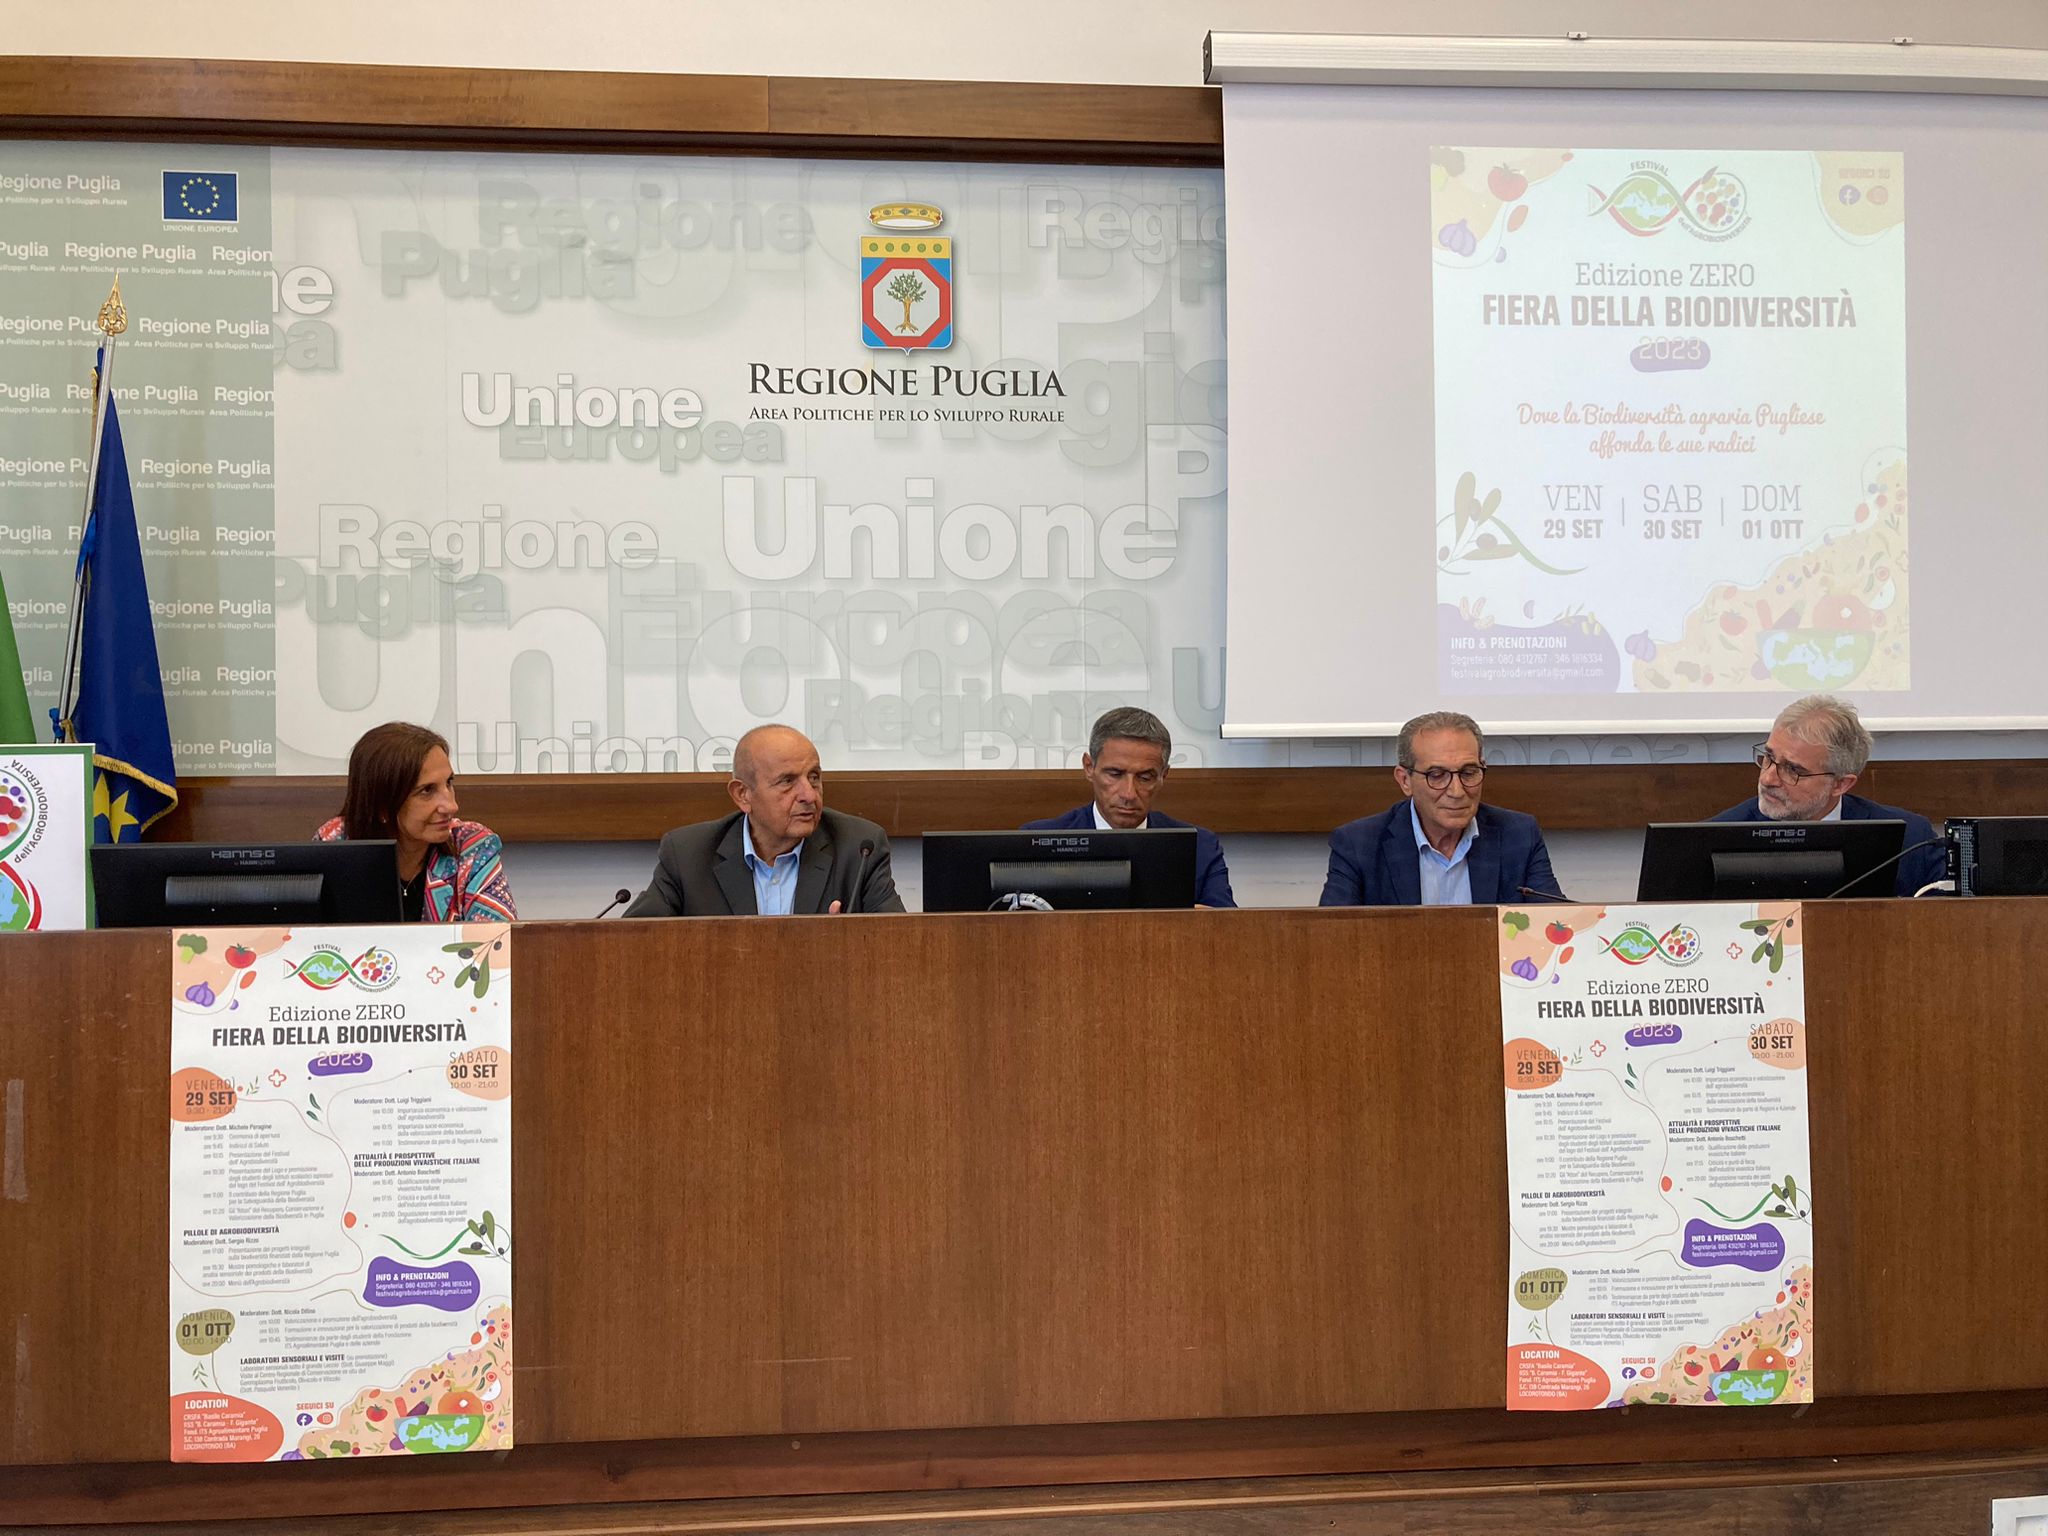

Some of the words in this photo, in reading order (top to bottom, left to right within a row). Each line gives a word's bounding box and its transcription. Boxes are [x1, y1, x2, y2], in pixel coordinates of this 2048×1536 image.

[1630, 160, 1669, 176] FESTIVAL
[0, 174, 62, 192] egione
[67, 175, 121, 193] Puglia
[478, 180, 812, 256] Regione
[65, 242, 137, 261] Regione
[143, 244, 195, 262] Puglia
[381, 231, 636, 312] Puglia
[1575, 262, 1683, 288] Edizione
[1690, 263, 1755, 288] ZERO
[1483, 294, 1561, 326] FIERA
[1571, 294, 1655, 327] DELLA
[1665, 288, 1856, 328] BIODIVERSITÀ
[139, 318, 211, 336] Regione
[216, 320, 269, 338] Puglia
[1638, 336, 1702, 360] 2023
[748, 362, 918, 396] REGIONE
[930, 365, 1067, 397] PUGLIA
[67, 384, 139, 401] Reone
[144, 386, 198, 403] Puglia
[461, 372, 703, 428] Unione
[749, 406, 788, 420] AREA
[794, 407, 874, 421] POLITICHE
[879, 410, 906, 422] PER
[910, 410, 929, 422] LO
[934, 409, 1004, 422] SVILUPPO
[1009, 409, 1065, 422] RURALE
[1517, 402, 1559, 425] Dove
[1563, 401, 1581, 425] la
[1582, 401, 1685, 425] Biodiversità
[1689, 408, 1751, 435] agraria
[1755, 402, 1825, 435] Pugliese
[500, 412, 786, 473] Europea
[1589, 430, 1654, 459] affonda
[1658, 430, 1673, 453] le
[1676, 437, 1703, 453] sue
[1708, 430, 1756, 453] radici
[142, 459, 212, 478] Regione
[218, 460, 271, 478] Puglia
[1544, 484, 1603, 512] VEN
[1643, 484, 1703, 513] SAB
[1742, 484, 1802, 512] DOM
[146, 527, 199, 546] Puglia
[721, 476, 1178, 581] Unione
[1544, 519, 1566, 540] 29
[1572, 519, 1603, 540] SET
[1643, 519, 1665, 540] 30
[1671, 519, 1703, 539] SET
[1742, 519, 1764, 539] 01
[1770, 519, 1804, 539] OTT
[317, 503, 660, 583] Regione
[9, 599, 66, 617] egione
[219, 600, 271, 618] Puglia
[1451, 637, 1475, 649] INFO
[1478, 637, 1487, 649] &
[1491, 636, 1567, 649] PRENOTAZIONI
[220, 740, 272, 758] Puglia
[457, 721, 738, 773] Unione
[1625, 921, 1650, 929] FESTIVAL
[313, 944, 341, 952] FESTIVAL
[1587, 980, 1660, 995] Edizione
[1664, 978, 1709, 993] ZERO
[269, 1006, 350, 1023] Edizione
[355, 1004, 406, 1020] ZERO
[1538, 1000, 1585, 1018] FIERA
[1592, 999, 1643, 1017] DELLA
[1650, 992, 1764, 1016] BIODIVERSITÀ
[212, 1027, 265, 1047] FIERA
[273, 1026, 330, 1045] DELLA
[337, 1018, 466, 1044] BIODIVERSITÀ
[1633, 1023, 1673, 1038] 2023
[1750, 1023, 1793, 1035] SABATO
[1751, 1036, 1766, 1049] 30
[1771, 1035, 1793, 1049] SET
[317, 1050, 363, 1067] 2023
[449, 1051, 498, 1064] SABATO
[1517, 1048, 1560, 1060] VENERDÌ
[1752, 1051, 1770, 1059] 10:00
[1777, 1051, 1794, 1059] 21:00
[450, 1065, 468, 1079] 30
[473, 1064, 498, 1078] SET
[1517, 1062, 1533, 1075] 29
[1538, 1061, 1560, 1075] SET
[186, 1076, 236, 1091] VENERDÌ
[451, 1081, 471, 1089] 10:00
[478, 1080, 498, 1089] 21:00
[186, 1093, 204, 1106] 29
[209, 1091, 235, 1105] SET
[354, 1160, 372, 1168] DELLE
[394, 1152, 435, 1160] PROSPETTIVE
[375, 1273, 391, 1281] INFO
[400, 1272, 449, 1280] PRENOTAZIONI
[1521, 1271, 1565, 1280] DOMENICA
[1520, 1282, 1536, 1294] 01
[1540, 1281, 1564, 1293] OTT
[182, 1312, 232, 1322] DOMENICA
[182, 1324, 199, 1338] 01
[205, 1323, 231, 1337] OTT
[1521, 1351, 1560, 1360] LOCATION
[185, 1399, 228, 1410] LOCATION
[296, 1402, 323, 1411] SEGUICI
[325, 1402, 334, 1410] SU
